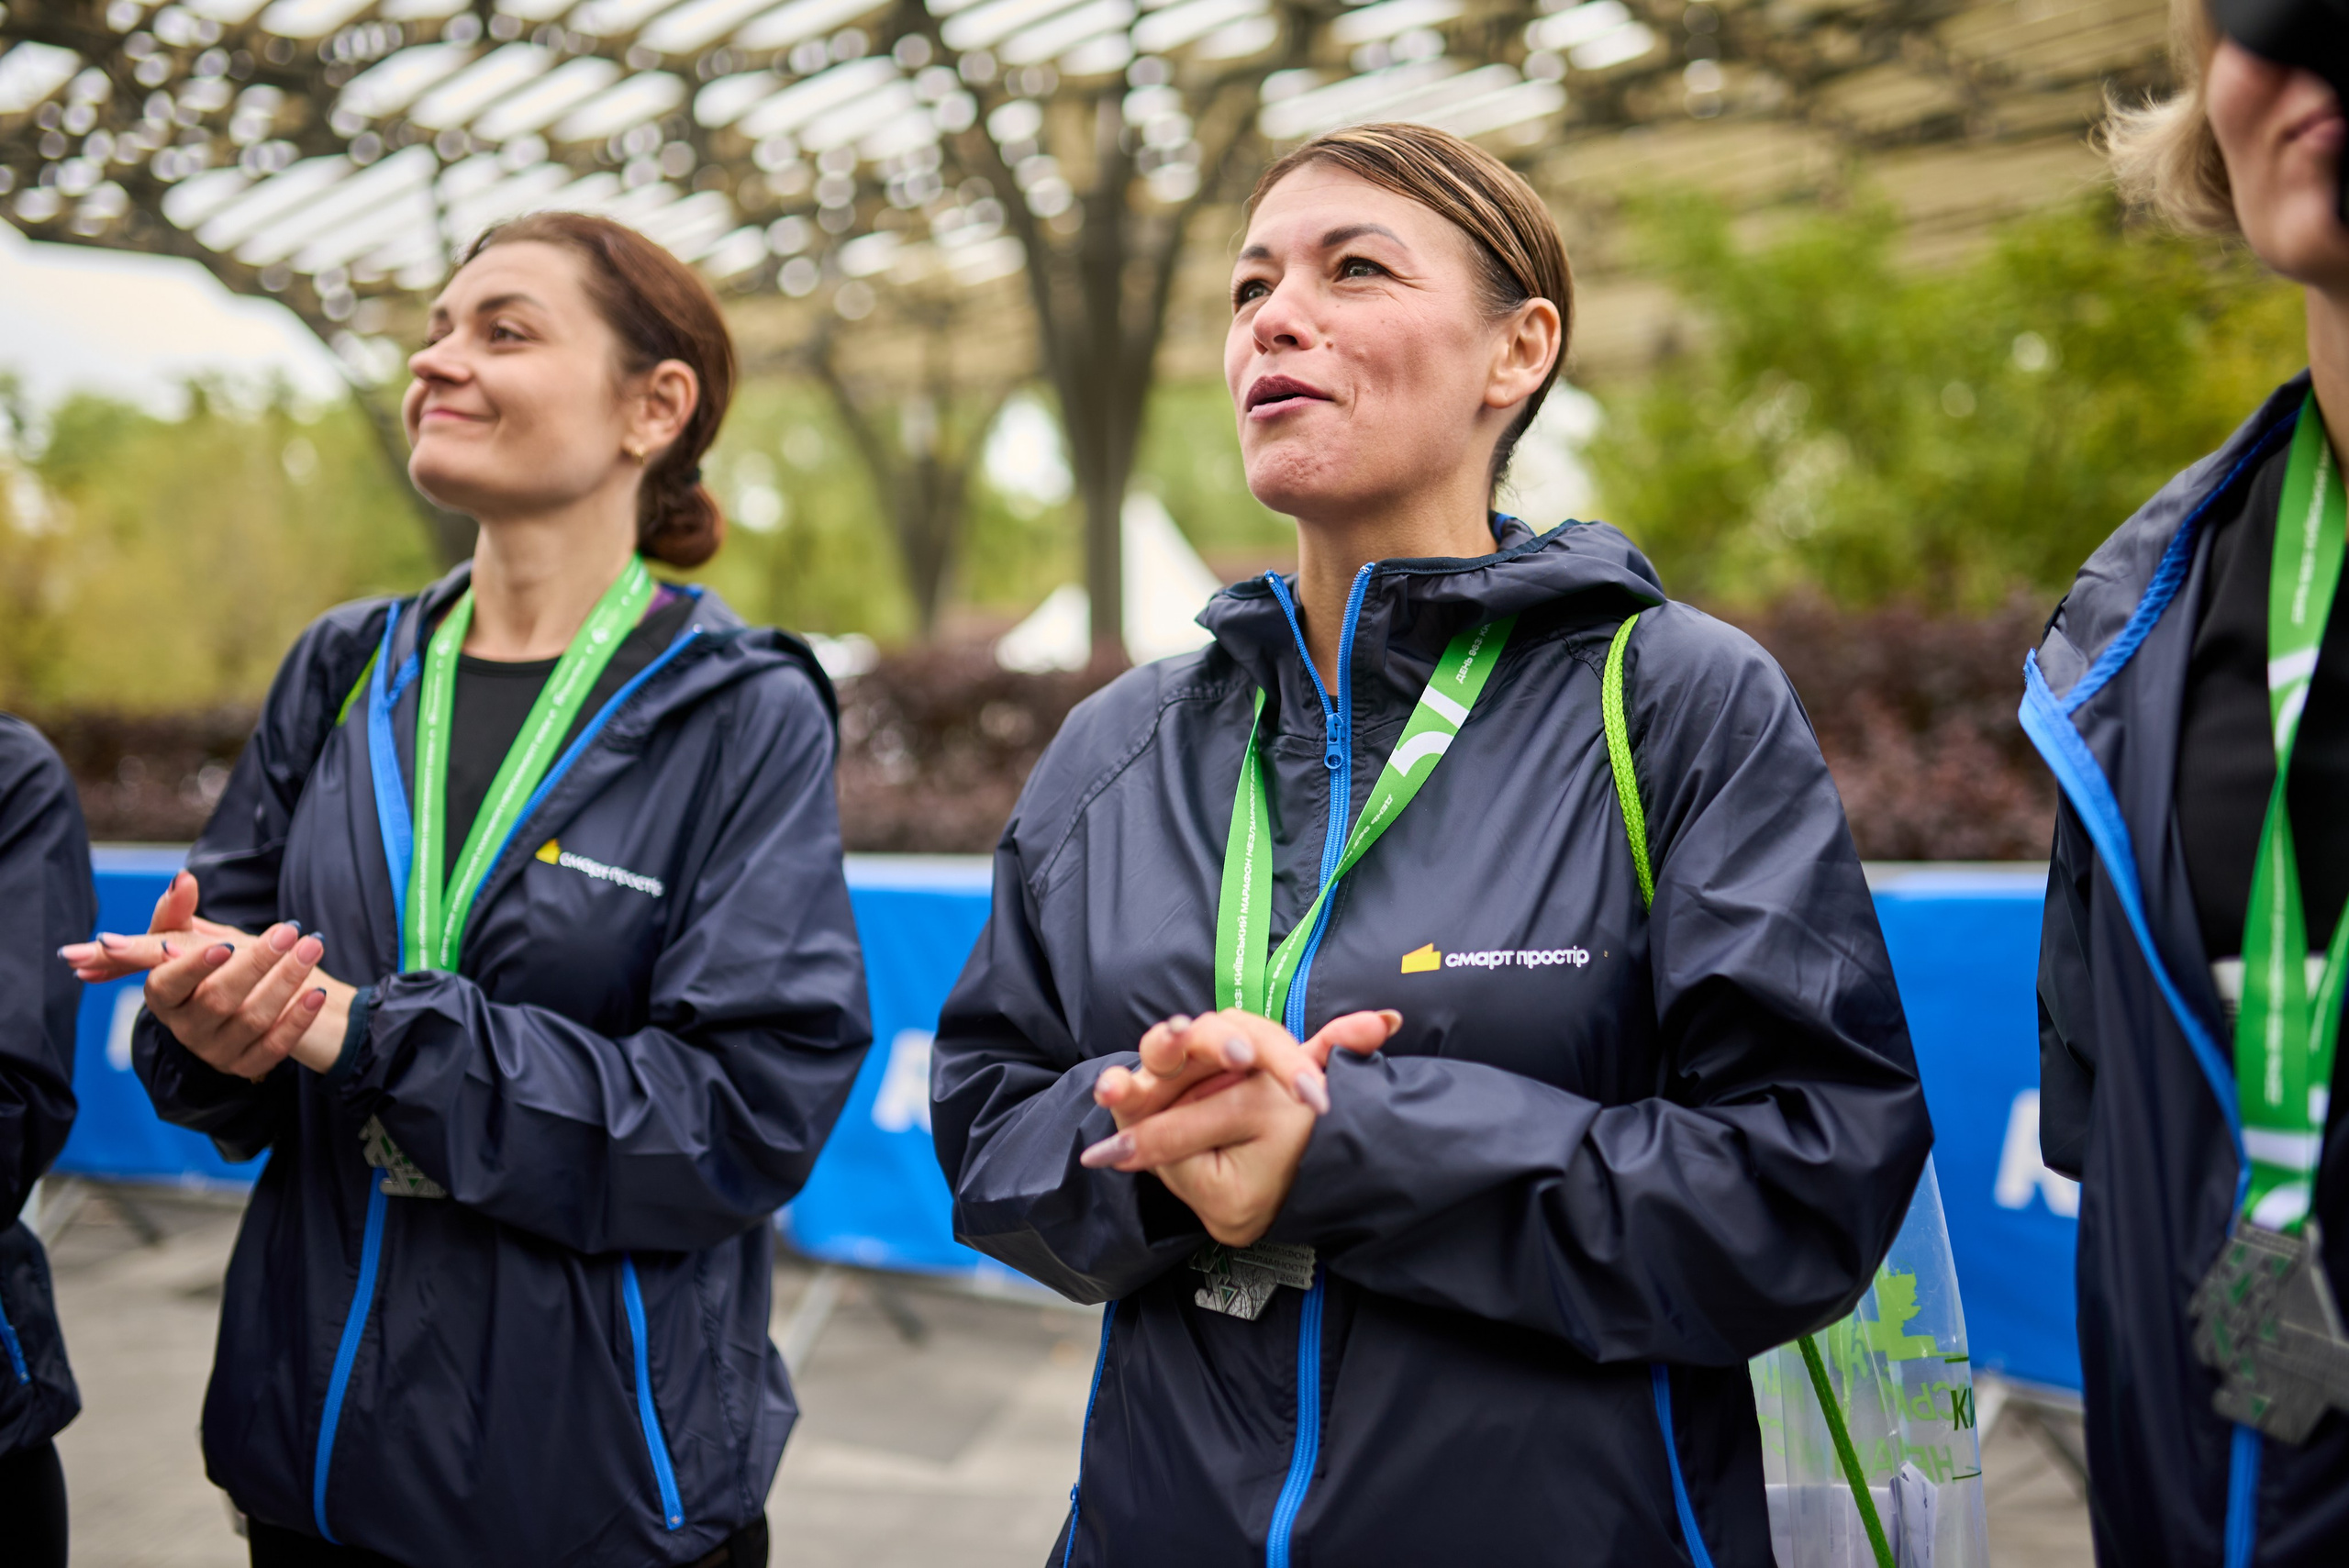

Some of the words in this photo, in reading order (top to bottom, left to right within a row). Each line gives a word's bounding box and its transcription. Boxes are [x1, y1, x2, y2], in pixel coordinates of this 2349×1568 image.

[1455, 657, 1474, 684] ДЕНЬ
[1468, 637, 1483, 657] 963:
[1240, 858, 1253, 914] МАРАФОН
[1233, 916, 1248, 986] КИЇВСЬКИЙ
[1445, 951, 1515, 970] смарт
[1516, 945, 1590, 970] простір
[1234, 988, 1242, 1009] 63:
[1258, 1242, 1309, 1262] МАРАФОН
[1279, 1273, 1305, 1285] 2024
